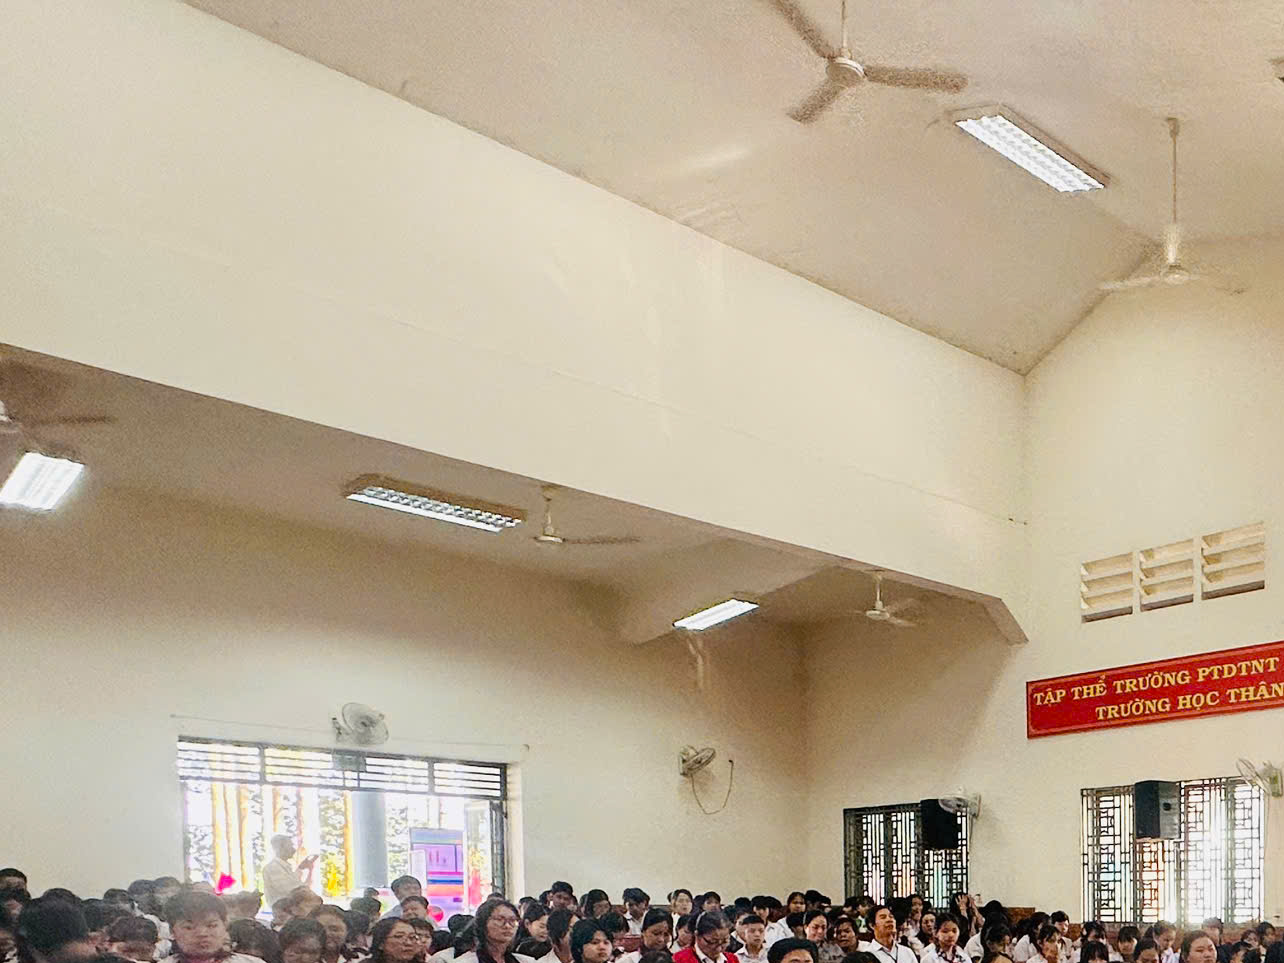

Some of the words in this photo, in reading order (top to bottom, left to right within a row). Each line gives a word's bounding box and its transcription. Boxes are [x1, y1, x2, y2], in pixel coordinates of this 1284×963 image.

[1033, 686, 1067, 707] TẬP
[1112, 669, 1190, 694] TRƯỜNG
[1197, 657, 1280, 682] PTDTNT
[1095, 695, 1170, 721] TRƯỜNG
[1177, 691, 1219, 710] HỌC
[1226, 681, 1284, 703] THÂN
